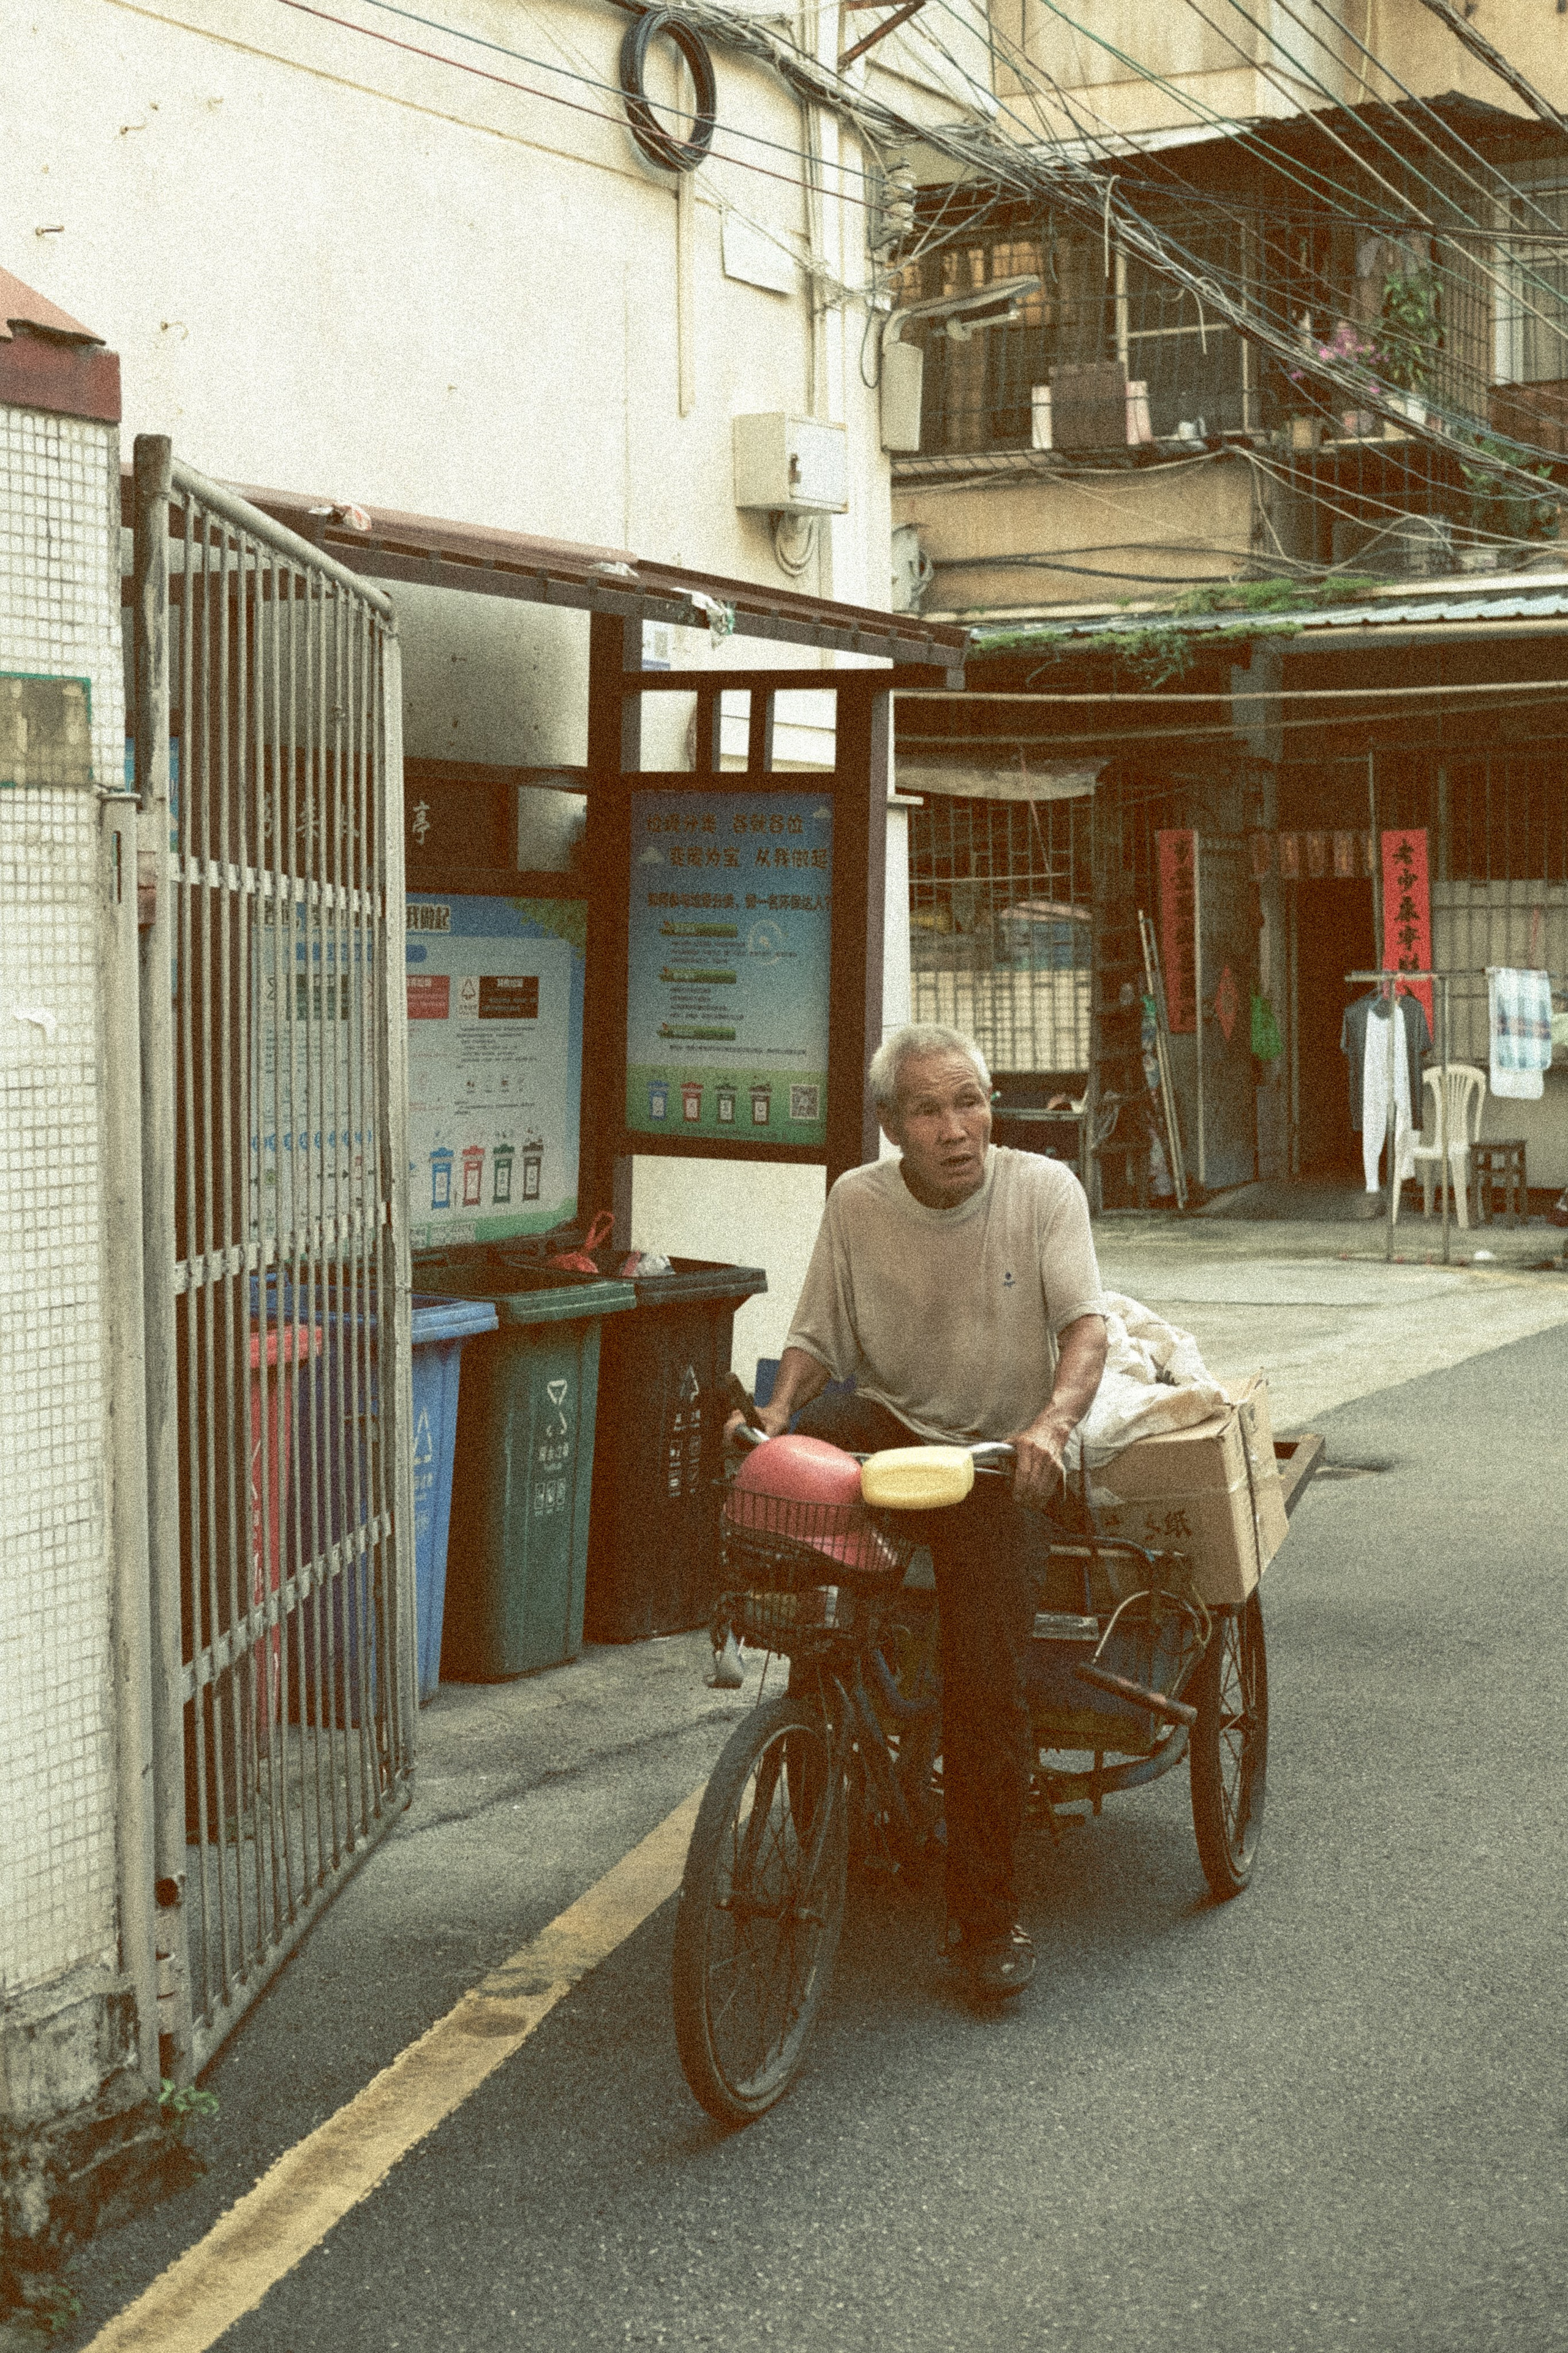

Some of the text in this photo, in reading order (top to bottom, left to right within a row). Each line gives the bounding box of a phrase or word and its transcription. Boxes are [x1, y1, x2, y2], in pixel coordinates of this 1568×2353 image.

[646, 813, 803, 834] 垃圾分类 各就各位
[669, 845, 829, 869] 变废为宝 从我做起
